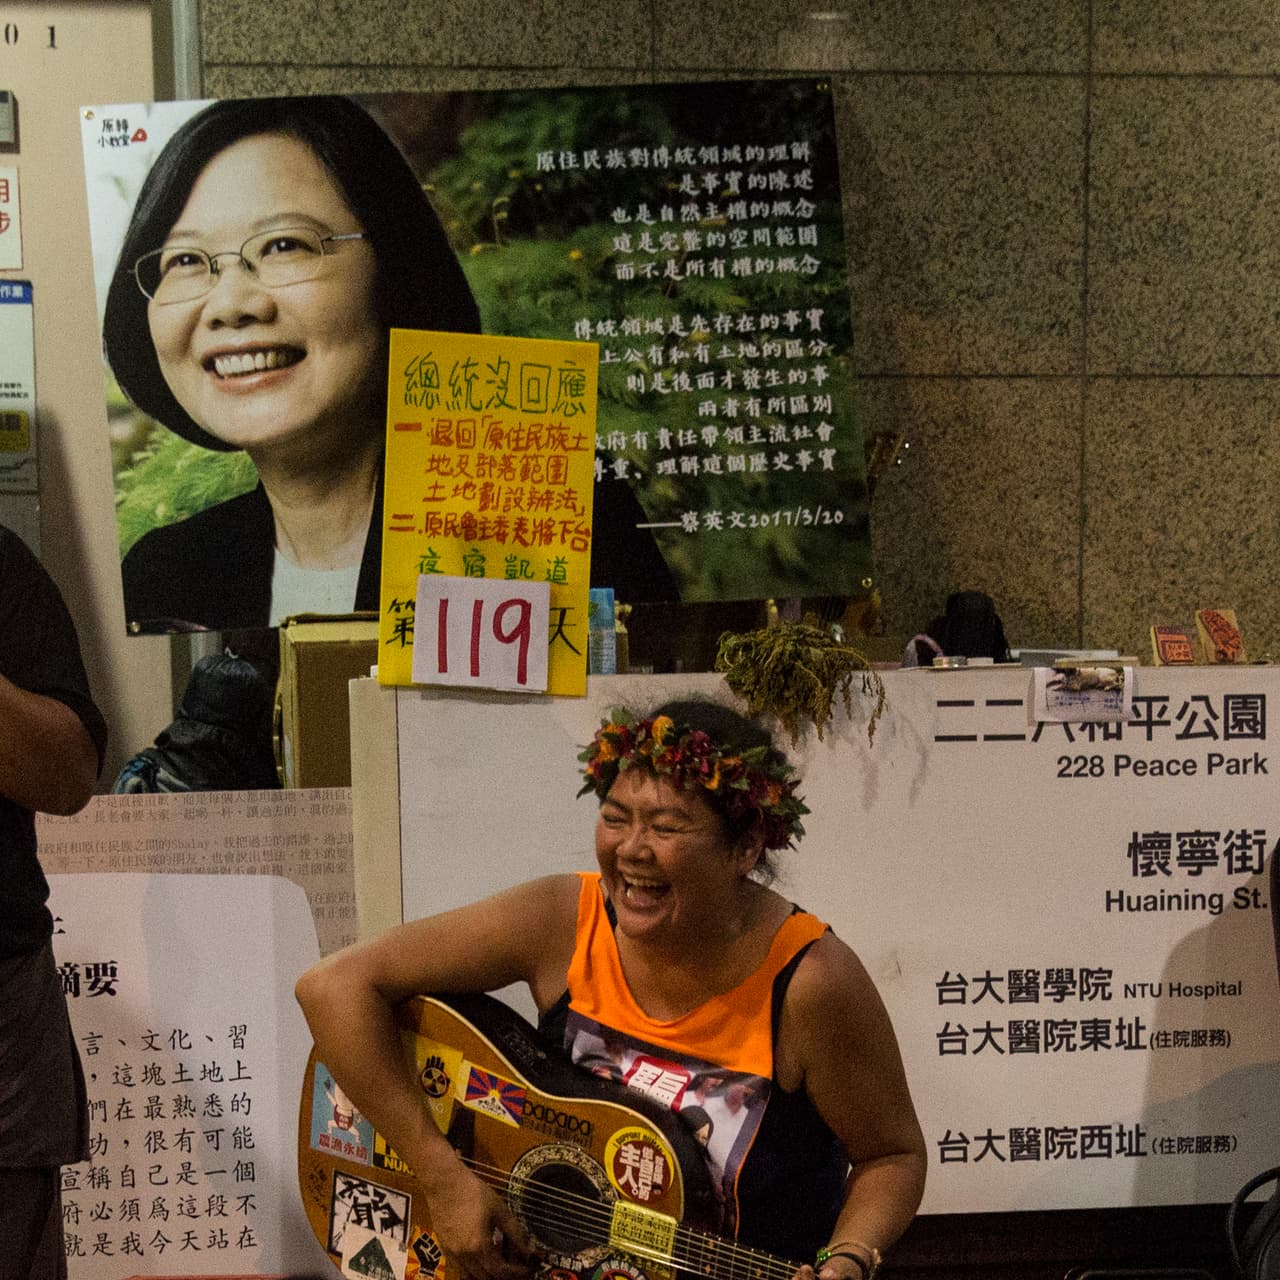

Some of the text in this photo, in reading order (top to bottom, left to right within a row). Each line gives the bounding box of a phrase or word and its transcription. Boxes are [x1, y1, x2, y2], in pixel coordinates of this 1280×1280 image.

[536, 141, 812, 172] 原住民族對傳統領域的理解
[678, 171, 815, 197] 是事實的陳述
[610, 199, 818, 225] 也是自然主權的概念
[616, 254, 820, 281] 而不是所有權的概念
[402, 351, 587, 417] 總統沒回應
[697, 393, 833, 419] 兩者有所區別
[425, 453, 569, 486] 地及部落範圍
[418, 546, 570, 587] 夜宿凱道
[437, 596, 533, 686] 119
[548, 606, 582, 657] 天
[1056, 752, 1270, 779] 228 Peace Park
[1126, 829, 1268, 878] 懷寧街
[1104, 887, 1269, 917] Huaining St.
[935, 967, 1243, 1006] 台大醫學院 NTU Hospital
[935, 1017, 1148, 1057] 台大醫院東址
[936, 1124, 1149, 1164] 台大醫院西址
